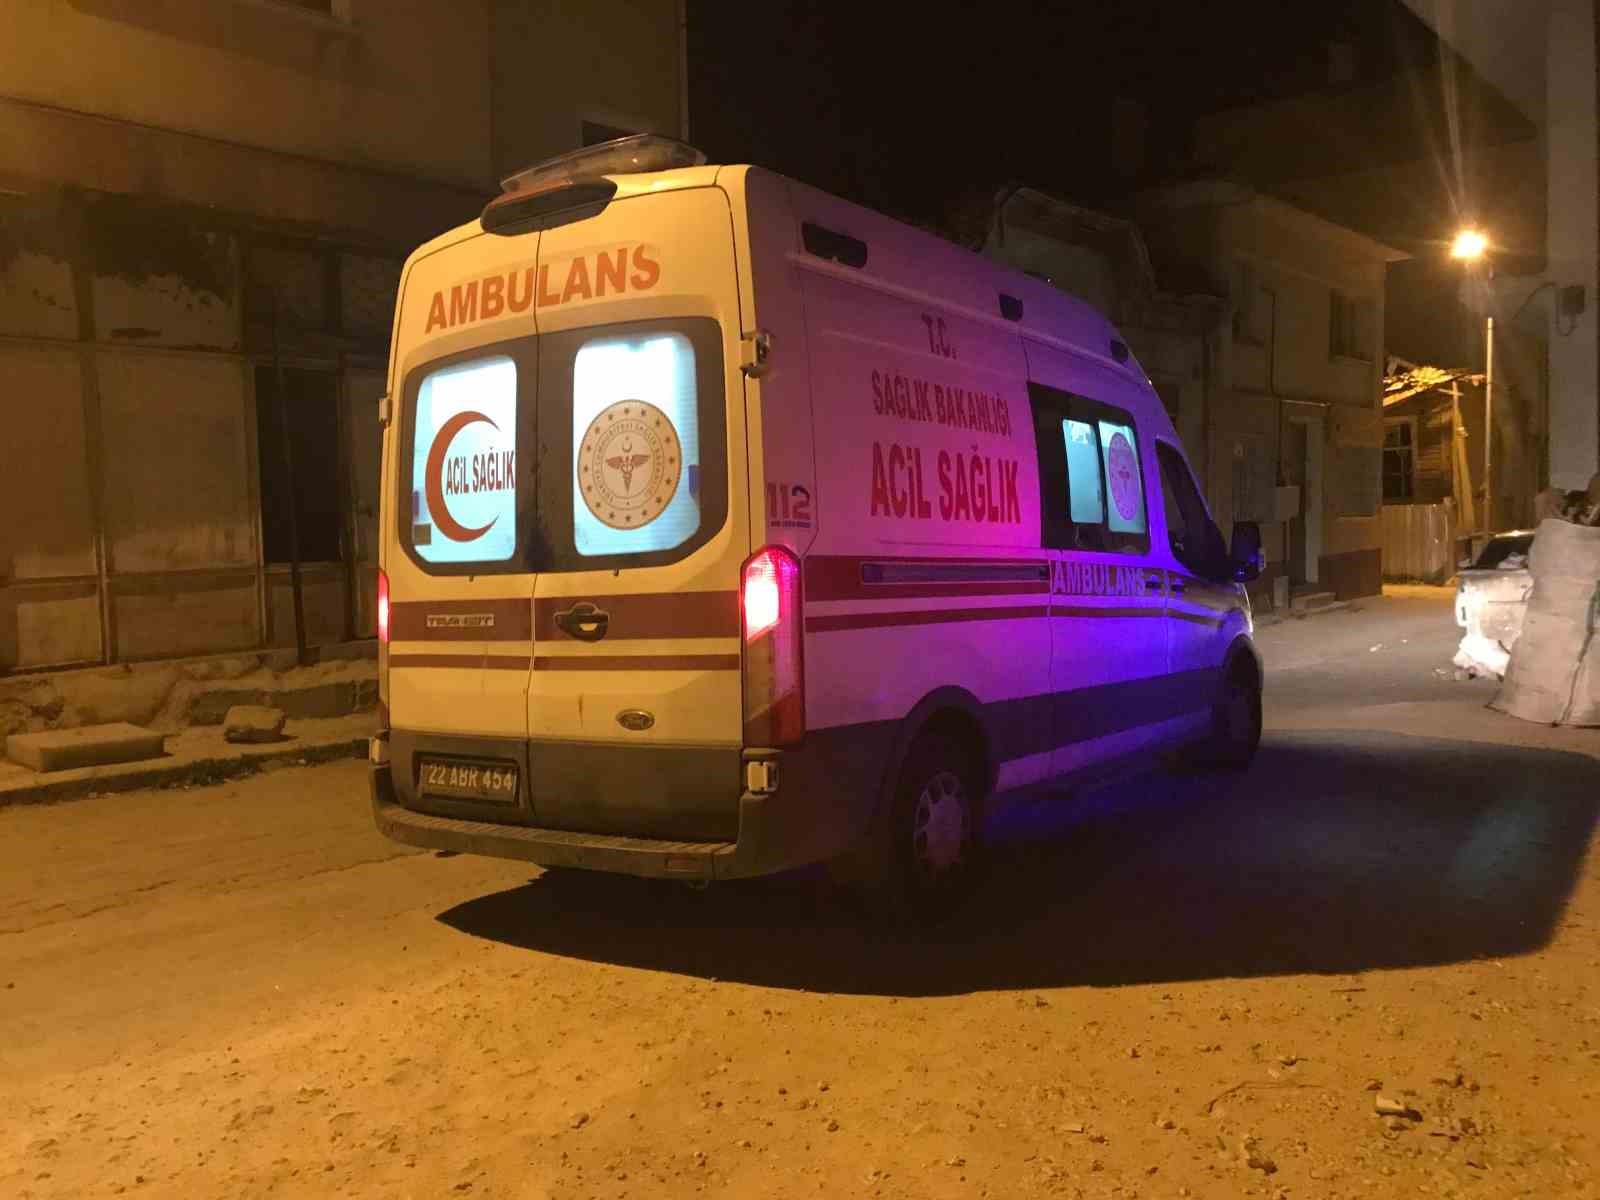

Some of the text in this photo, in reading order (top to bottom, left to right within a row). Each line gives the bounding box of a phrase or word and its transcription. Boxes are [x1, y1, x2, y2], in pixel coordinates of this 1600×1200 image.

[425, 244, 660, 334] AMBULANS
[921, 312, 957, 360] T.C.
[472, 446, 514, 493] SAĞLIK
[938, 444, 1020, 524] SAĞLIK
[767, 482, 811, 520] 112
[1053, 560, 1147, 596] AMBULANS
[428, 765, 446, 785] 22
